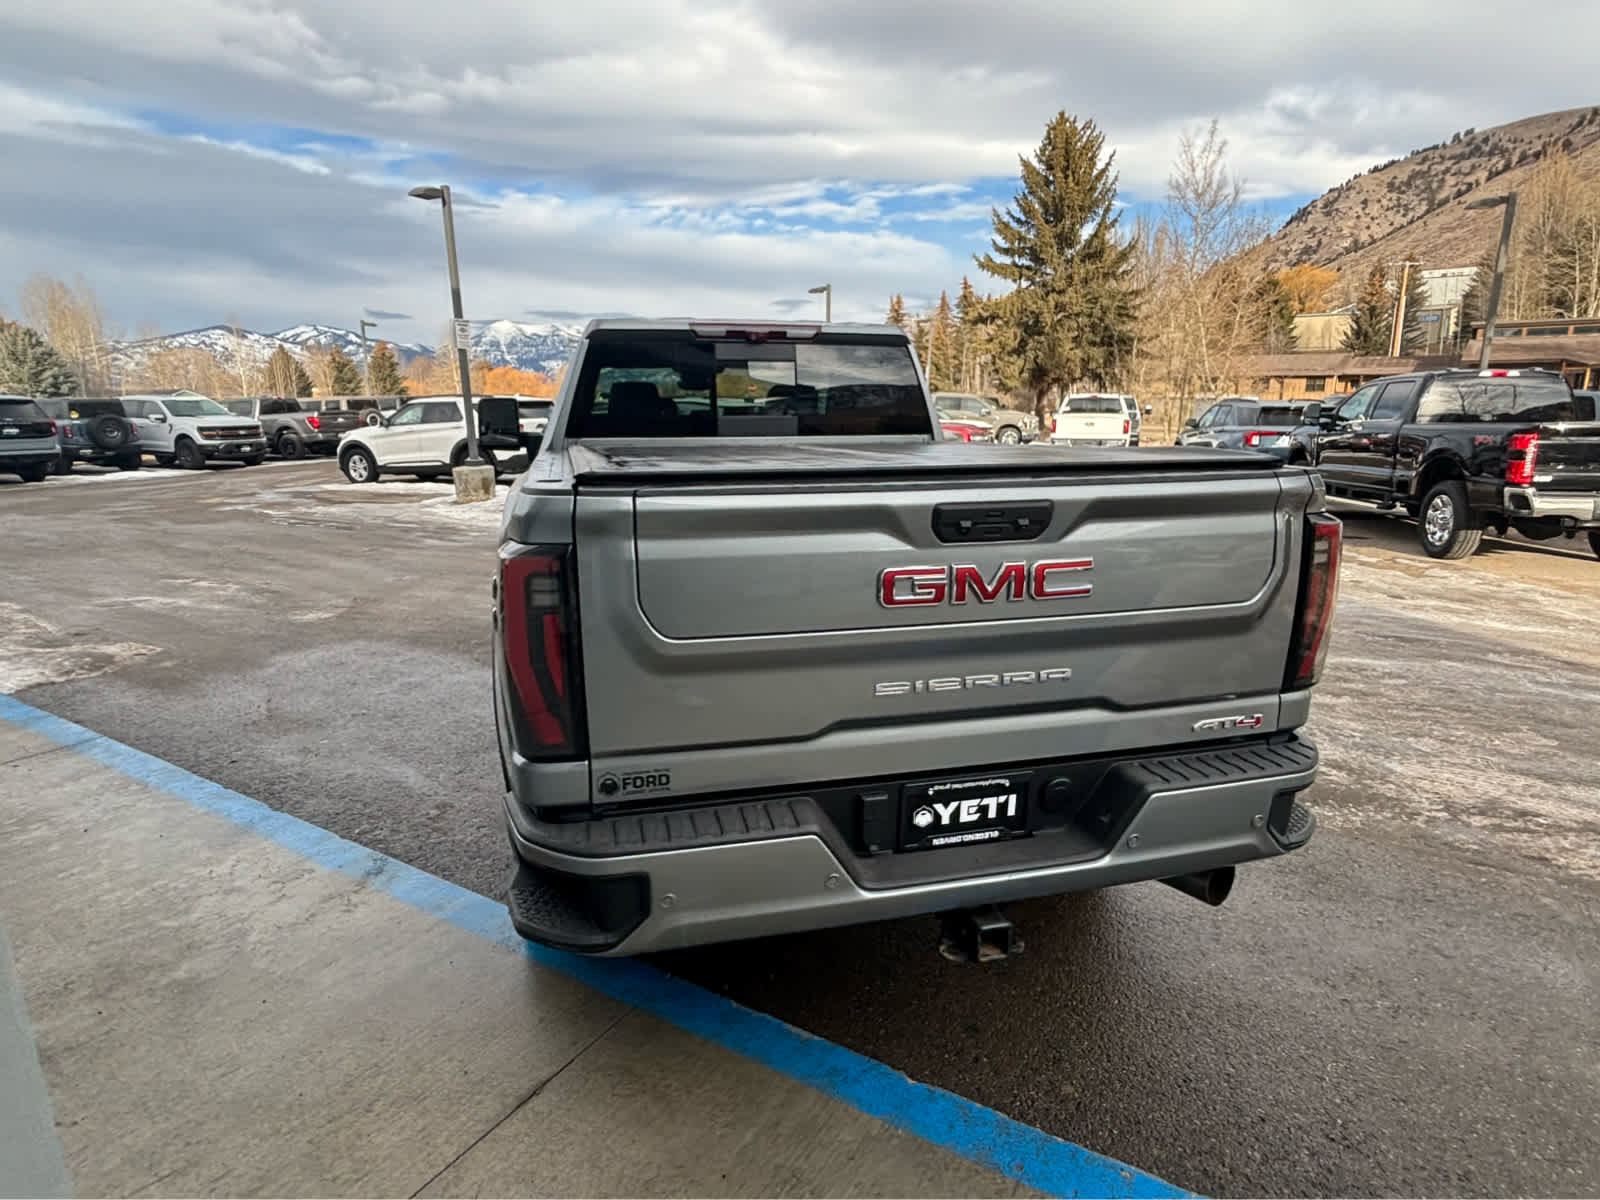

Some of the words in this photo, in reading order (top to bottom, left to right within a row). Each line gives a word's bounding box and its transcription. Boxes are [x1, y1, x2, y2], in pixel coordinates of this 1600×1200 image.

[879, 556, 1095, 608] GMC
[874, 668, 1073, 696] SIERRA
[622, 774, 671, 790] FORD
[932, 794, 1017, 825] YETI
